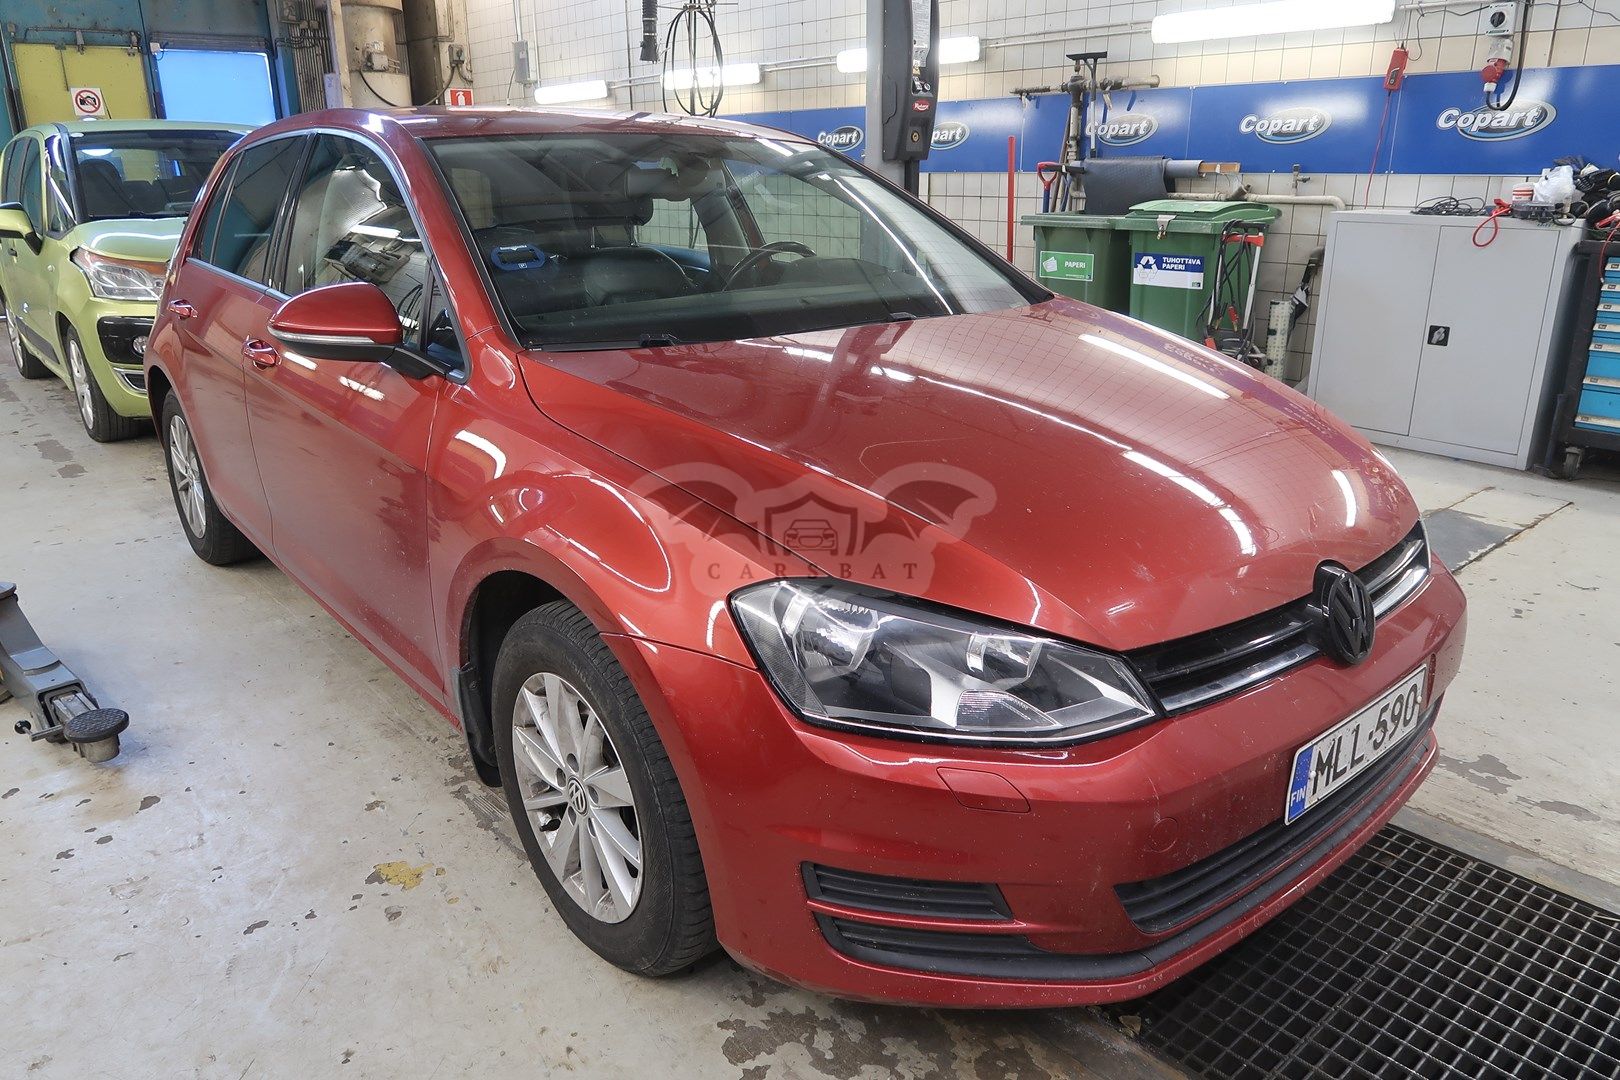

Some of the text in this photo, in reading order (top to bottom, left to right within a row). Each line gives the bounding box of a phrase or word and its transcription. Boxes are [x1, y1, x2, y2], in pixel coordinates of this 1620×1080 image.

[1241, 114, 1319, 136] Copart
[1438, 105, 1541, 131] Copart
[817, 131, 858, 146] Copart
[931, 127, 962, 144] part
[1064, 261, 1086, 269] PAPERI
[1162, 257, 1201, 265] TUHOTTAVA
[1312, 684, 1418, 796] MLL-590
[1290, 786, 1306, 806] FIN
